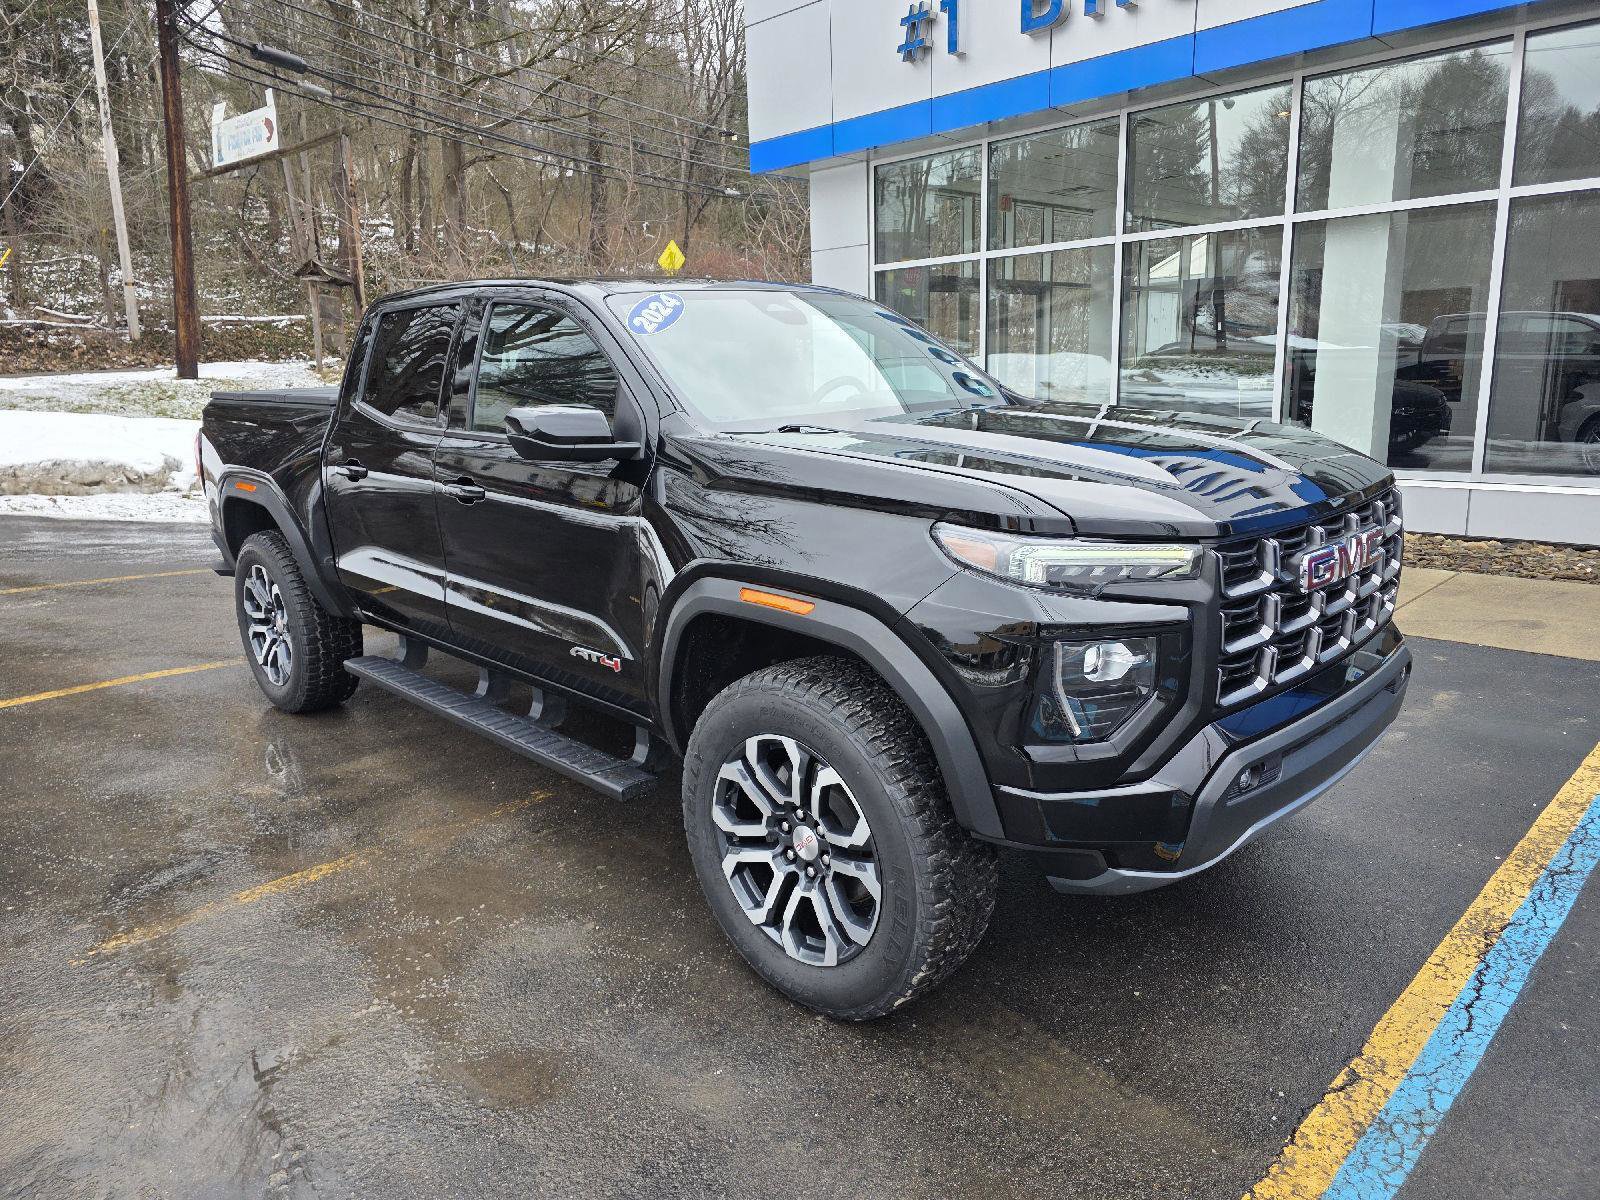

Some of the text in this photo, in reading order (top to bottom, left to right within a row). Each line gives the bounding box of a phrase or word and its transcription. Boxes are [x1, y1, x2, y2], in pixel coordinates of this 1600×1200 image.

[633, 293, 681, 333] 2024
[1300, 526, 1384, 594] GMC
[569, 646, 621, 672] AT4
